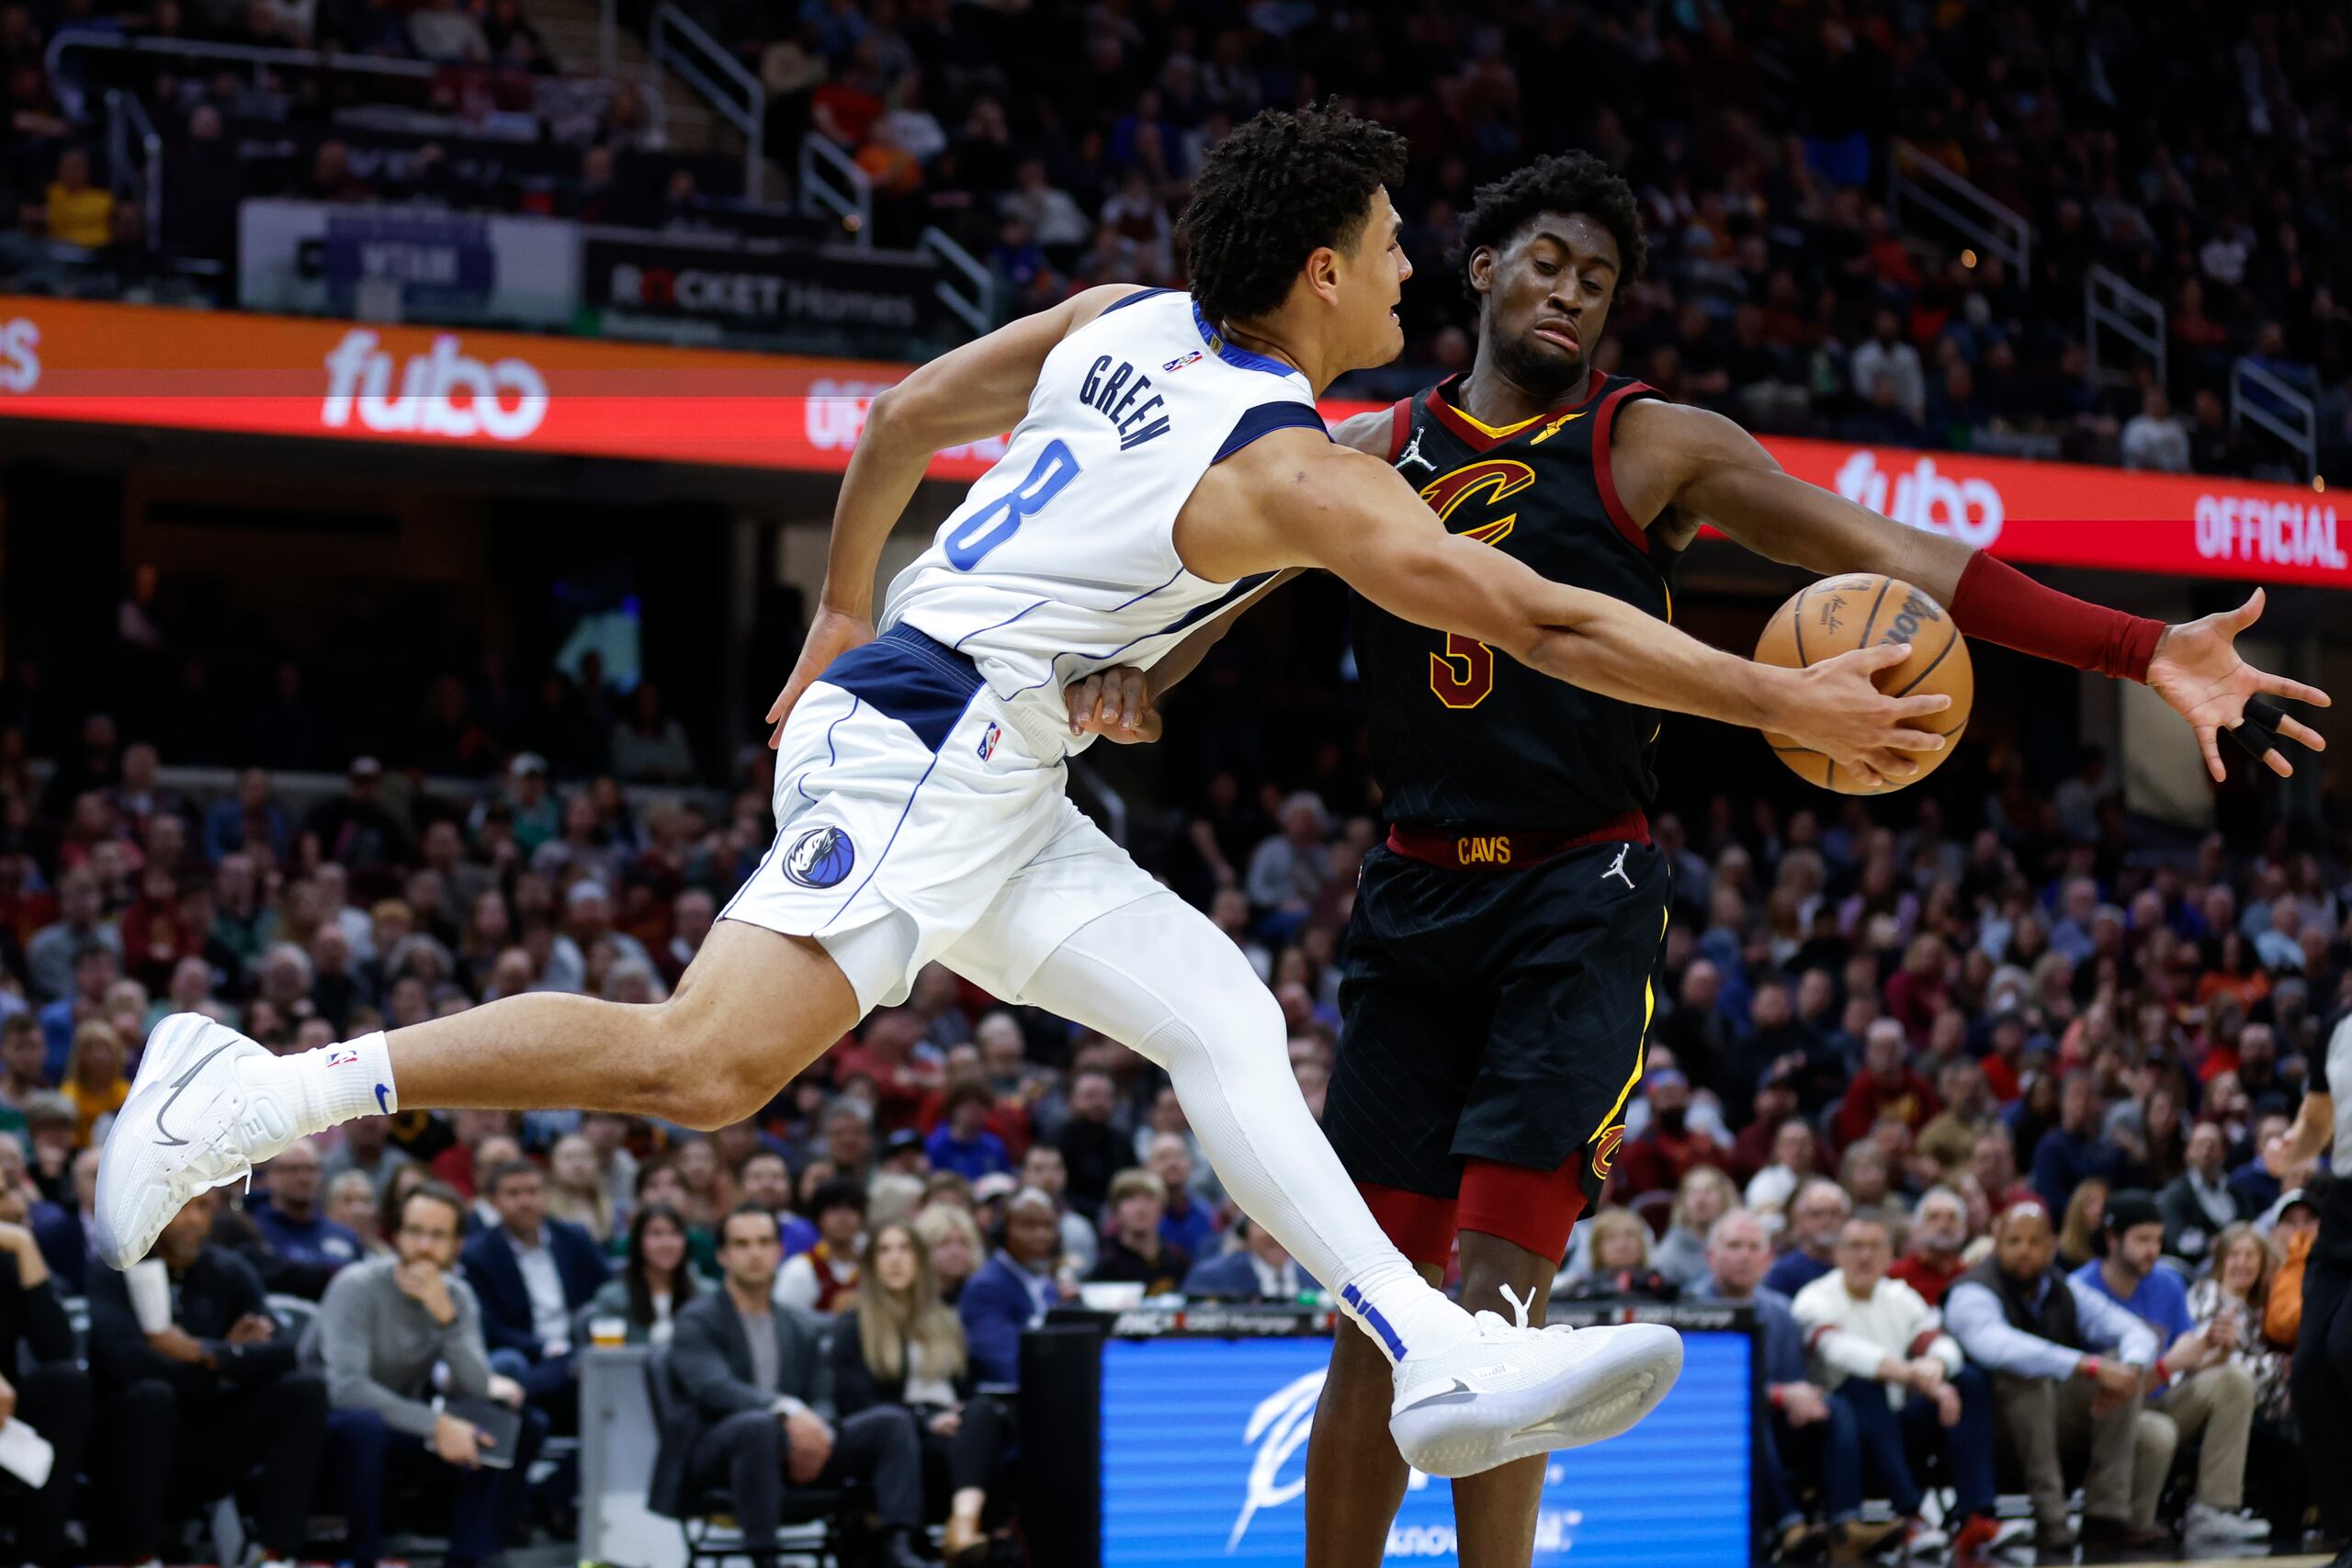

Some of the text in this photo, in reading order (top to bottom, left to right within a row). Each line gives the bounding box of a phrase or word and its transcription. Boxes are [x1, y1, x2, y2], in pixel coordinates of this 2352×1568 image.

[609, 263, 783, 318] ROCKET
[322, 329, 549, 440] fubo
[1080, 355, 1170, 452] GREEN
[943, 438, 1083, 573] 8
[2193, 494, 2348, 570] OFFICIAL
[1457, 835, 1512, 865] CAVS
